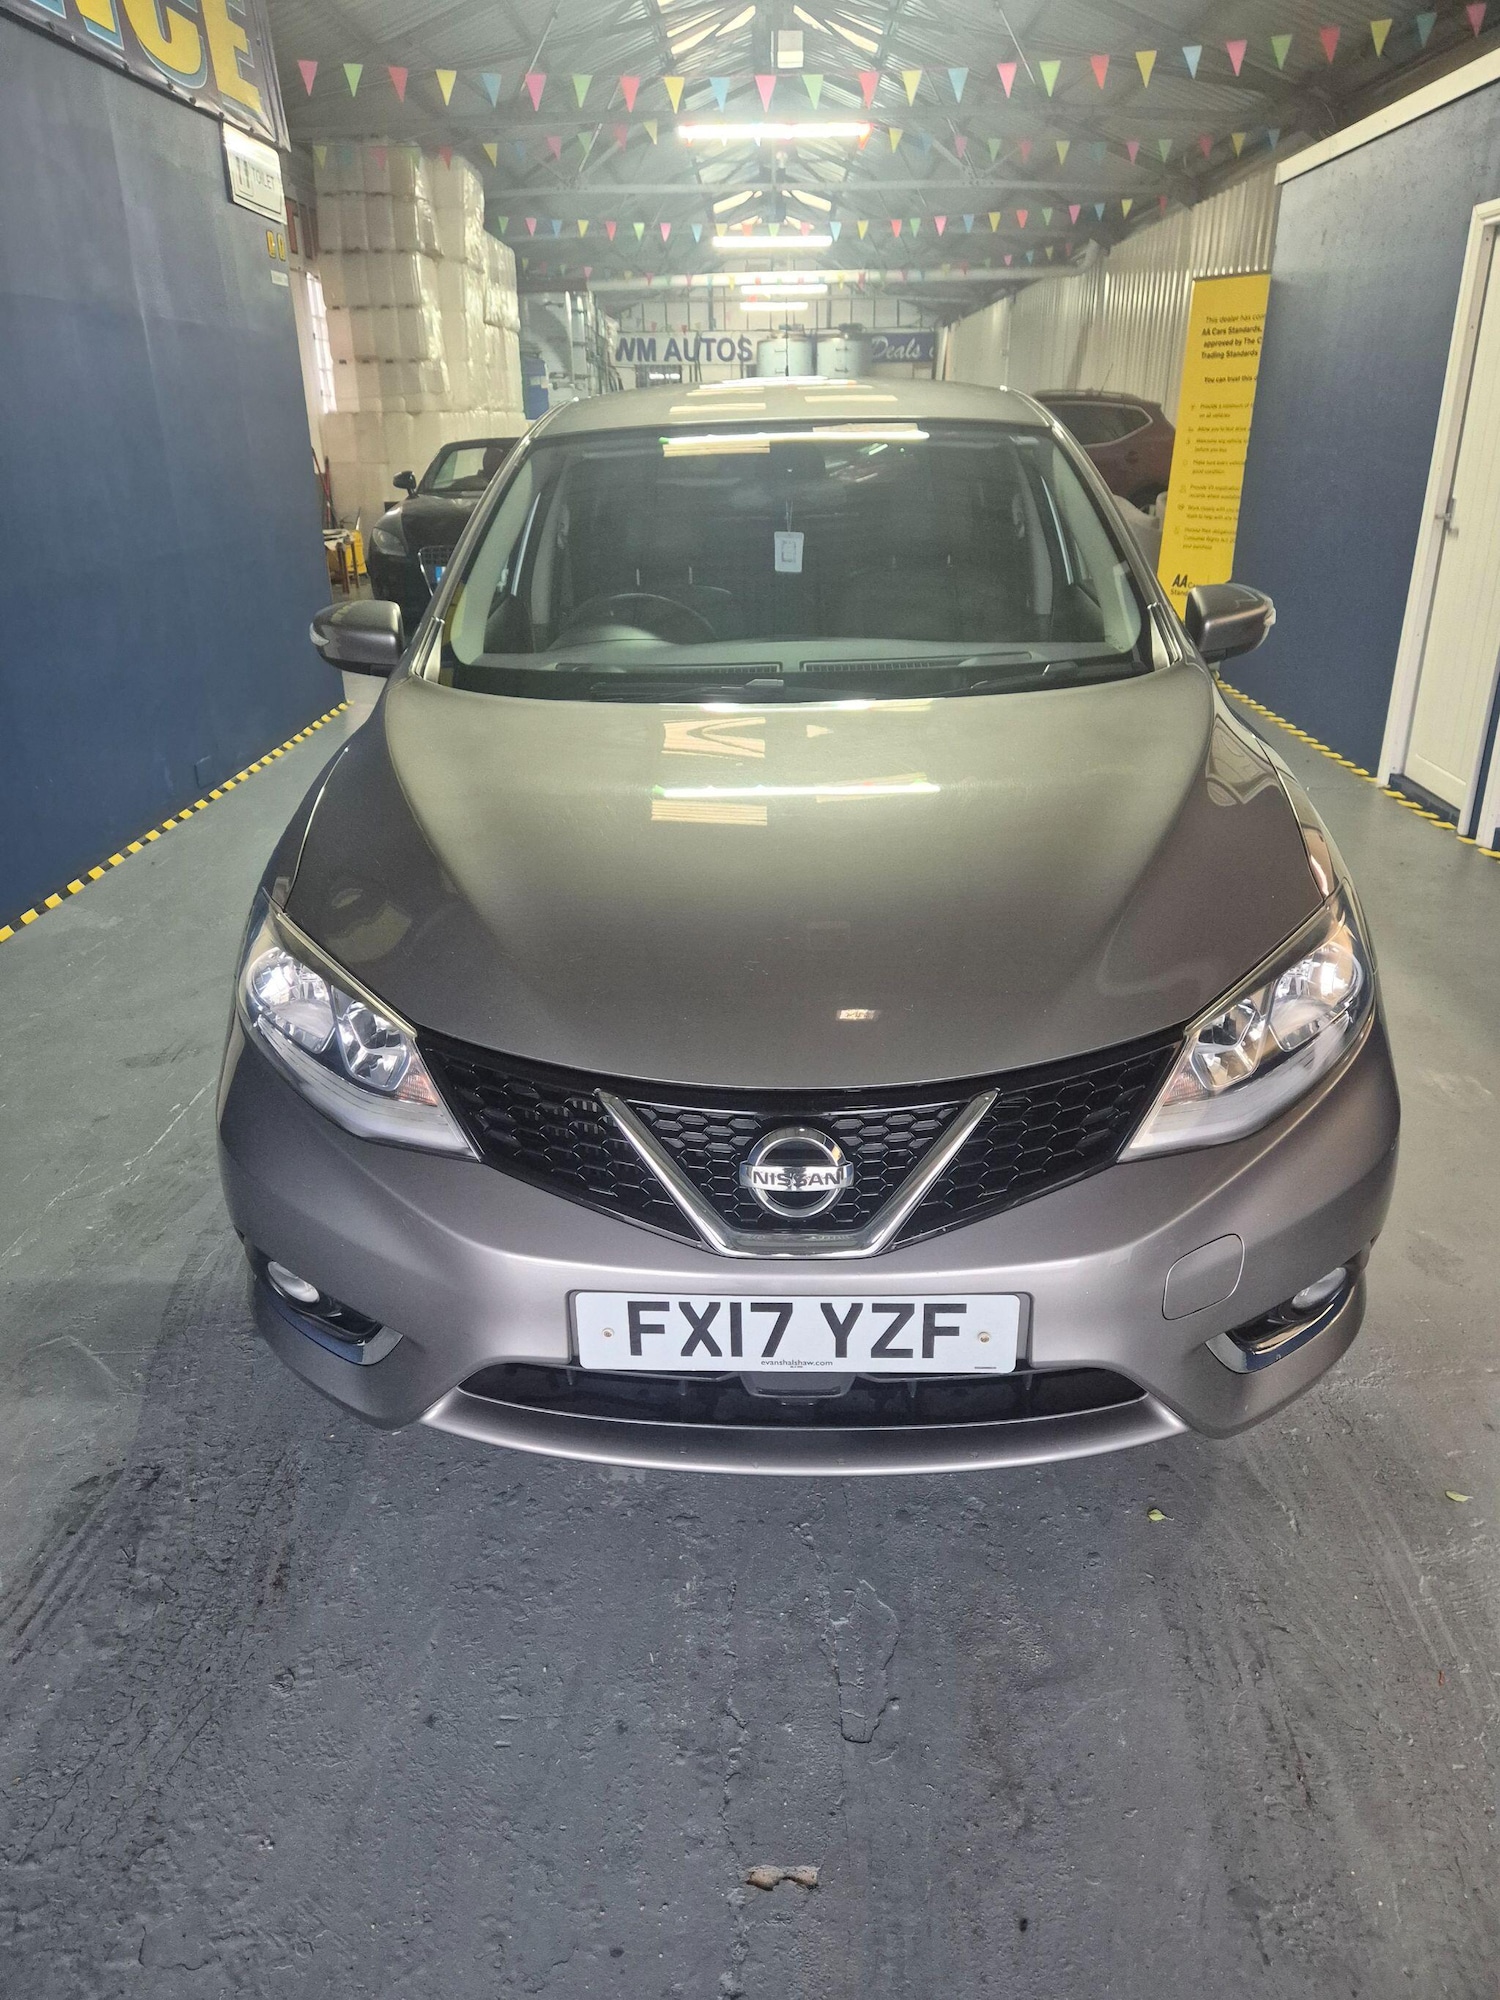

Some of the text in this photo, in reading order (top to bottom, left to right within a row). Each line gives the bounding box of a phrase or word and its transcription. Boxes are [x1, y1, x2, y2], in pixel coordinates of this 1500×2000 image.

[251, 166, 275, 190] TOILET
[1220, 315, 1239, 323] dealer
[1202, 328, 1211, 336] AA
[1212, 327, 1227, 336] Cars
[664, 334, 753, 362] AUTOS
[871, 334, 921, 359] Deals
[1204, 339, 1234, 348] approved
[1244, 337, 1256, 345] The
[1202, 350, 1258, 359] Trading Standards
[1172, 573, 1188, 588] AA
[753, 1171, 842, 1187] NISSAN
[627, 1301, 967, 1359] FX17 YZF
[760, 1359, 834, 1367] evanshalshaw.com
